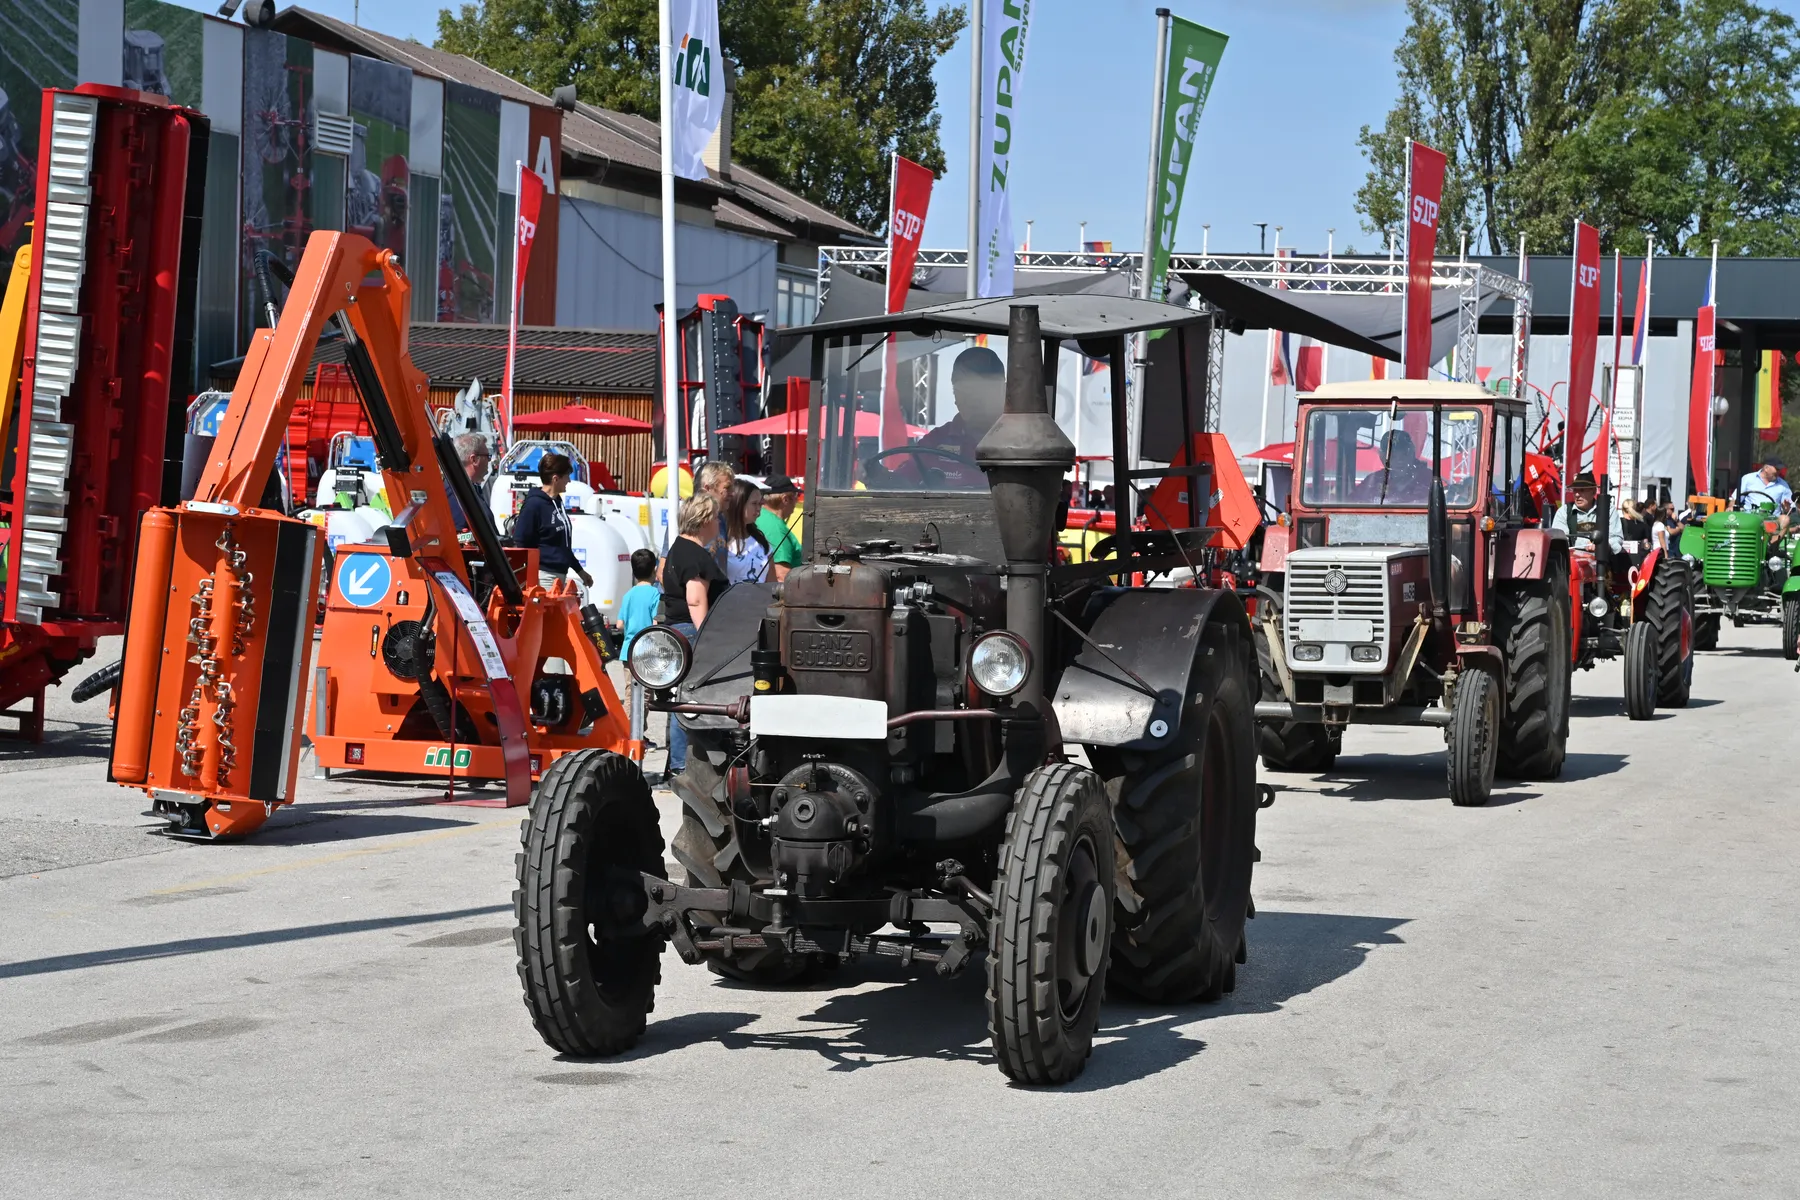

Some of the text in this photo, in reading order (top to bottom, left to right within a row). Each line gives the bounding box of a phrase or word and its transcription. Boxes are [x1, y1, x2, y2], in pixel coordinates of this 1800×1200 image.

[1014, 0, 1031, 74] Spraye
[534, 135, 556, 195] A
[895, 208, 921, 241] SIP
[1413, 195, 1438, 228] SIP
[808, 633, 853, 650] LANZ
[794, 650, 868, 668] BULLDOG
[424, 746, 473, 769] ino
